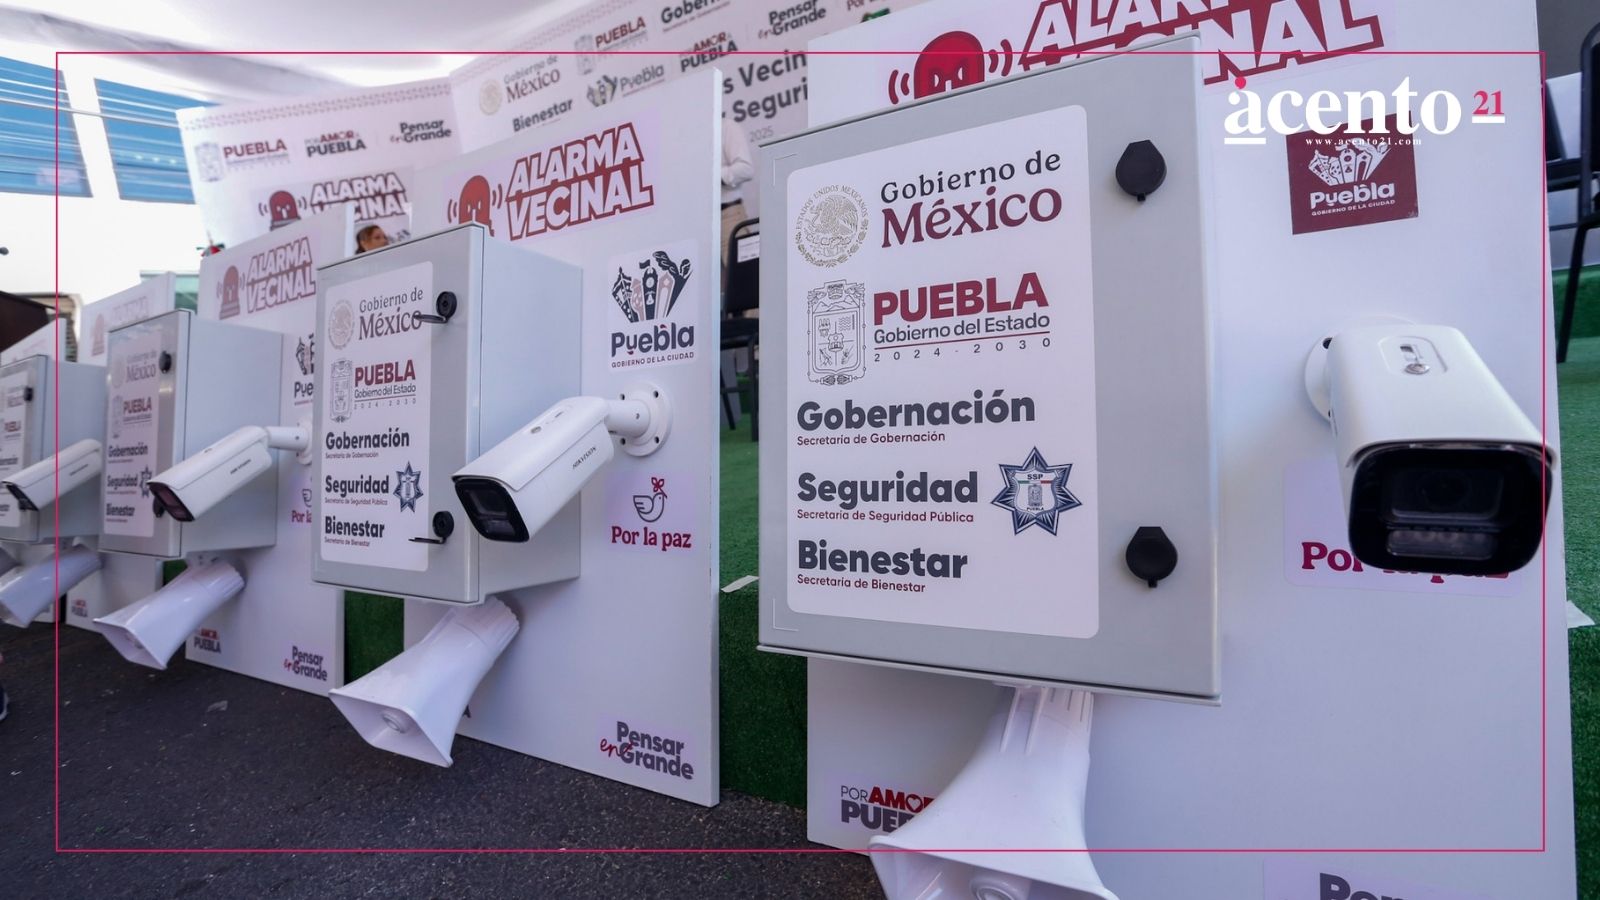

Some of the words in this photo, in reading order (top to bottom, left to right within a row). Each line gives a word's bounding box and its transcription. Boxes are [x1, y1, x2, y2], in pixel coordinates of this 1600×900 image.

[769, 0, 819, 25] Pensar
[772, 8, 826, 35] Grande
[595, 16, 646, 48] PUEBLA
[694, 32, 727, 52] AMOR
[504, 59, 546, 84] Gobierno
[546, 54, 559, 66] de
[681, 40, 738, 72] PUEBLA
[738, 49, 807, 87] Vecin
[506, 68, 561, 103] México
[620, 65, 665, 91] Puebla
[733, 77, 808, 122] Seguri
[400, 120, 444, 134] Pensar
[512, 99, 573, 132] Bienestar
[320, 130, 355, 143] AMOR
[404, 128, 452, 143] Grande
[750, 125, 775, 143] 2025
[223, 138, 288, 158] PUEBLA
[307, 139, 367, 158] PUEBLA
[506, 122, 645, 198] ALARMA
[310, 172, 407, 207] ALARMA
[880, 162, 1016, 204] Gobierno
[1025, 150, 1062, 176] de
[505, 161, 655, 241] VECINAL
[1310, 182, 1396, 209] Puebla
[1311, 207, 1347, 217] GOBIERNO
[1368, 199, 1396, 208] CIUDAD
[881, 185, 1063, 248] México
[247, 236, 313, 283] ALARMA
[246, 263, 316, 313] VECINAL
[359, 293, 408, 314] Gobierno
[410, 286, 424, 302] de
[873, 272, 1049, 326] PUEBLA
[359, 306, 423, 340] México
[874, 324, 951, 344] Gobierno
[953, 318, 981, 336] del
[985, 312, 1051, 333] Estado
[611, 322, 694, 358] Puebla
[611, 358, 646, 368] GOBIERNO
[657, 355, 666, 363] LA
[667, 351, 695, 361] CIUDAD
[355, 359, 416, 388] PUEBLA
[355, 388, 382, 399] Gobierno
[382, 384, 393, 396] del
[393, 383, 416, 395] Estado
[123, 396, 152, 414] PUEBLA
[797, 389, 1036, 431] Gobernación
[325, 427, 410, 450] Gobernación
[797, 434, 850, 446] Secretaría
[853, 433, 868, 444] de
[870, 430, 946, 444] Gobernación
[325, 473, 390, 498] Seguridad
[797, 470, 978, 510] Seguridad
[325, 515, 385, 538] Bienestar
[797, 508, 849, 520] Secretaría
[852, 509, 866, 520] de
[868, 510, 927, 523] Seguridad
[930, 511, 974, 523] Pública
[611, 525, 640, 545] Por
[643, 527, 657, 546] la
[661, 533, 692, 551] paz
[798, 539, 968, 578] Bienestar
[797, 573, 851, 587] Secretaría
[854, 578, 869, 589] de
[871, 579, 926, 593] Bienestar
[194, 636, 222, 653] PUEBLA
[292, 646, 324, 666] Pensar
[292, 661, 328, 681] Grande
[616, 720, 685, 756] Pensar
[600, 738, 632, 758] en
[620, 743, 694, 780] Grande
[841, 785, 868, 802] POR
